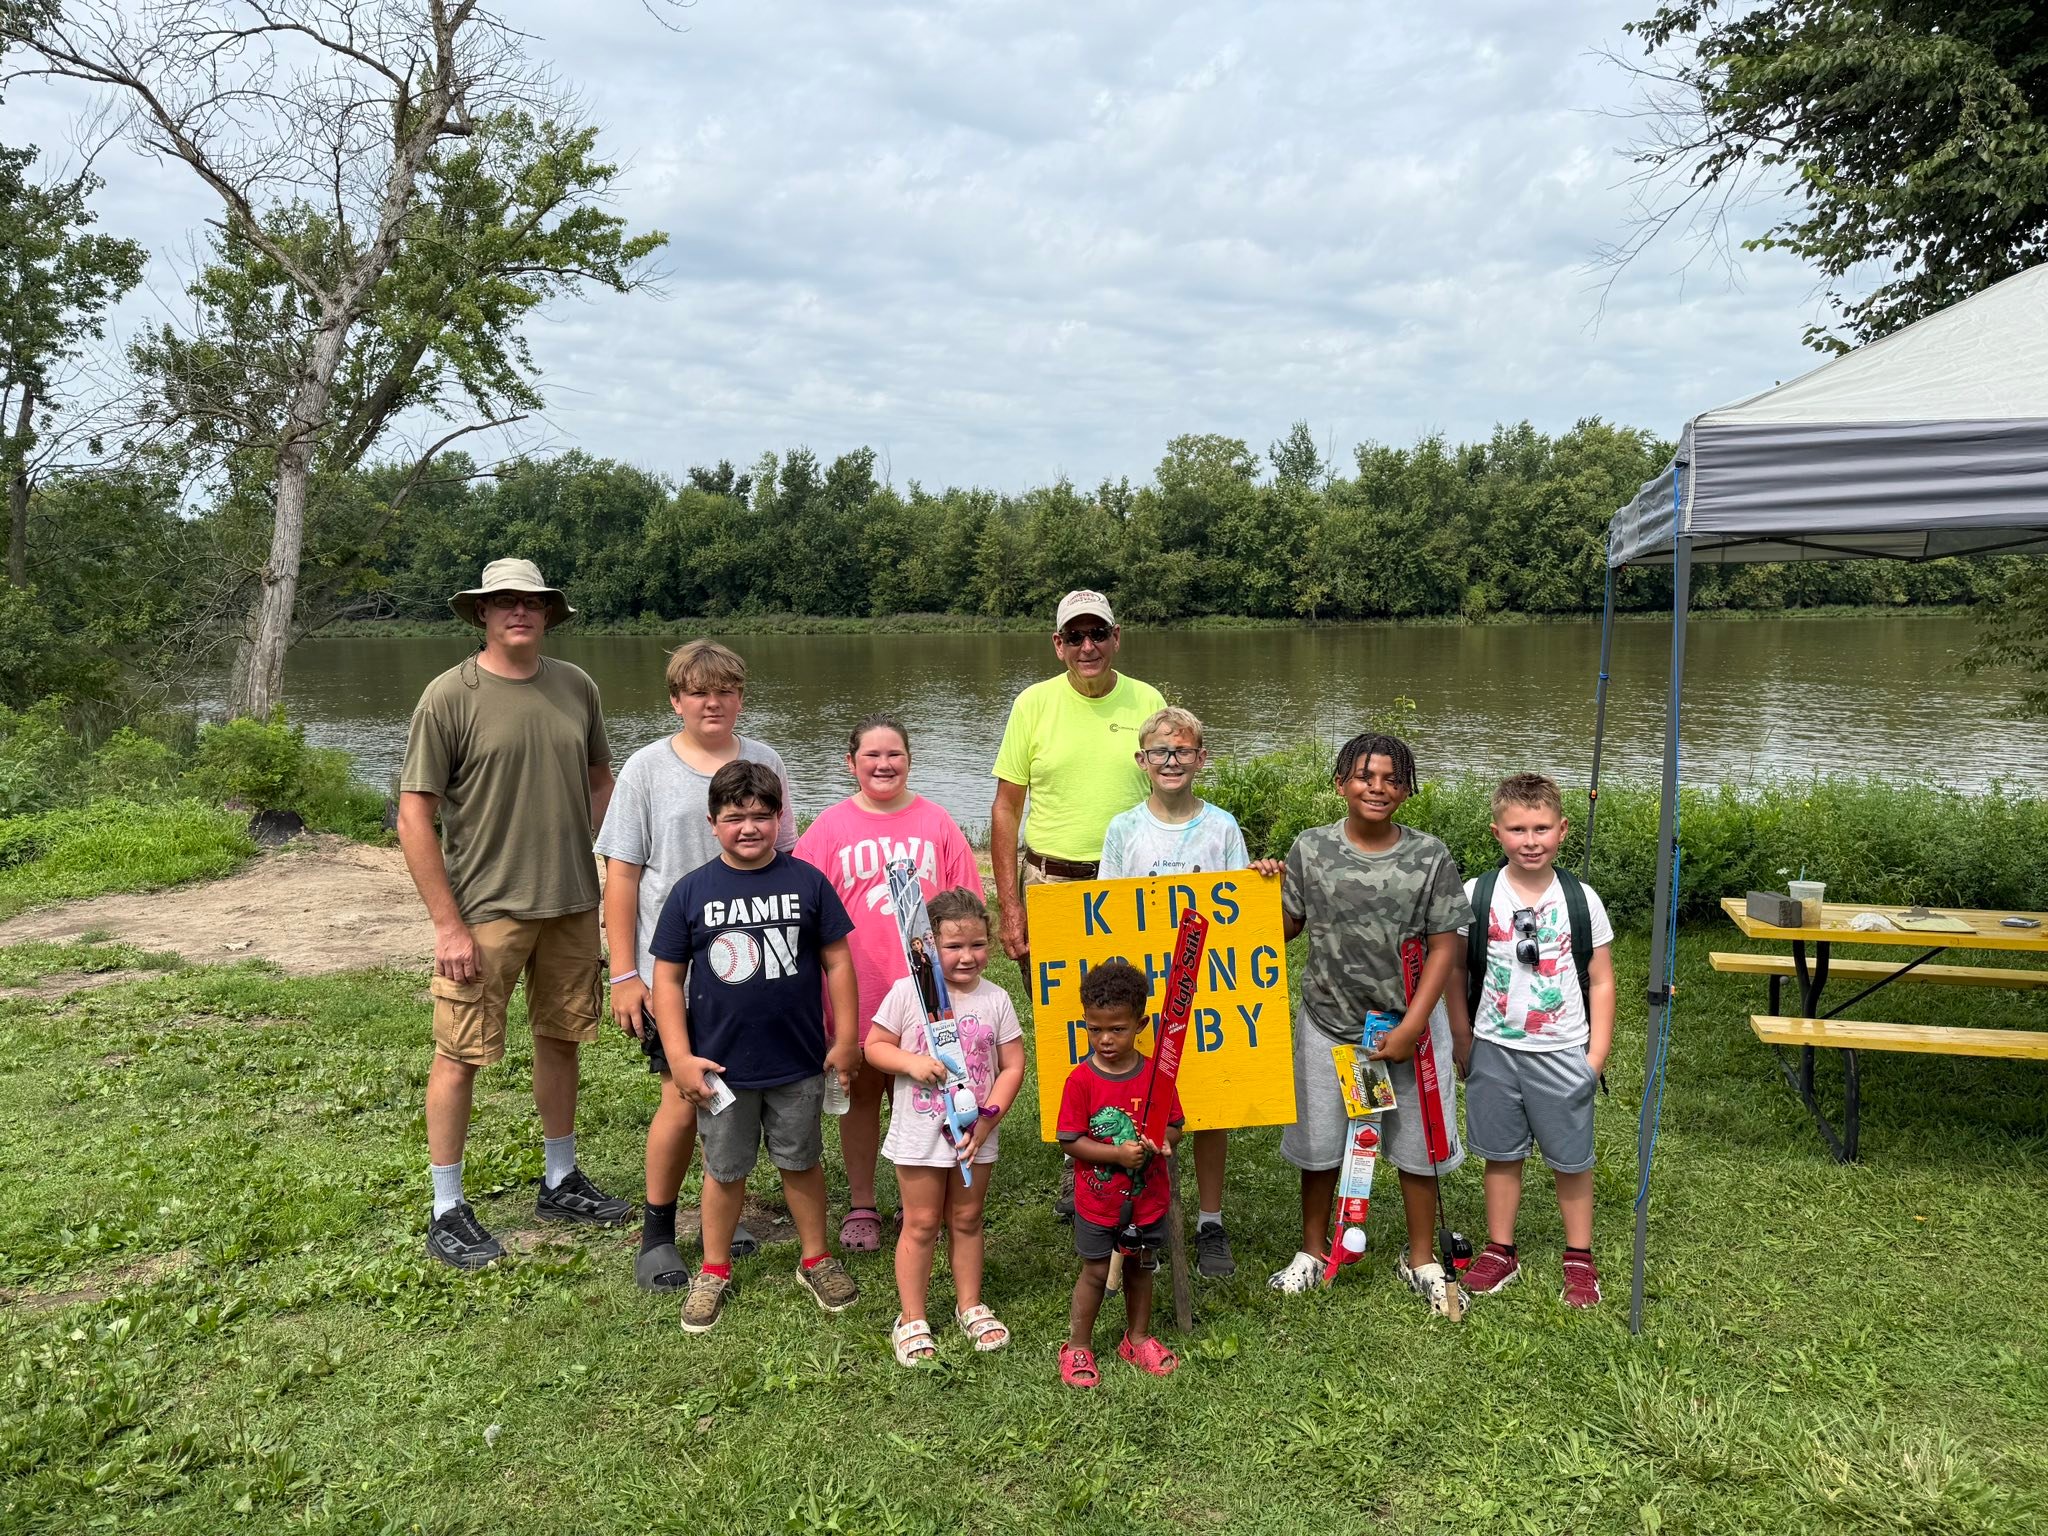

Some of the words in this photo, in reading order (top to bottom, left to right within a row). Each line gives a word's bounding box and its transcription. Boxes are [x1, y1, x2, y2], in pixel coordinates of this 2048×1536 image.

[839, 836, 938, 890] IOWA
[1163, 860, 1186, 869] Reamy
[703, 893, 801, 928] GAME
[1083, 881, 1240, 936] KIDS
[1182, 928, 1202, 970] Stik
[1171, 969, 1196, 1018] Ugly
[1067, 1003, 1263, 1065] DBY
